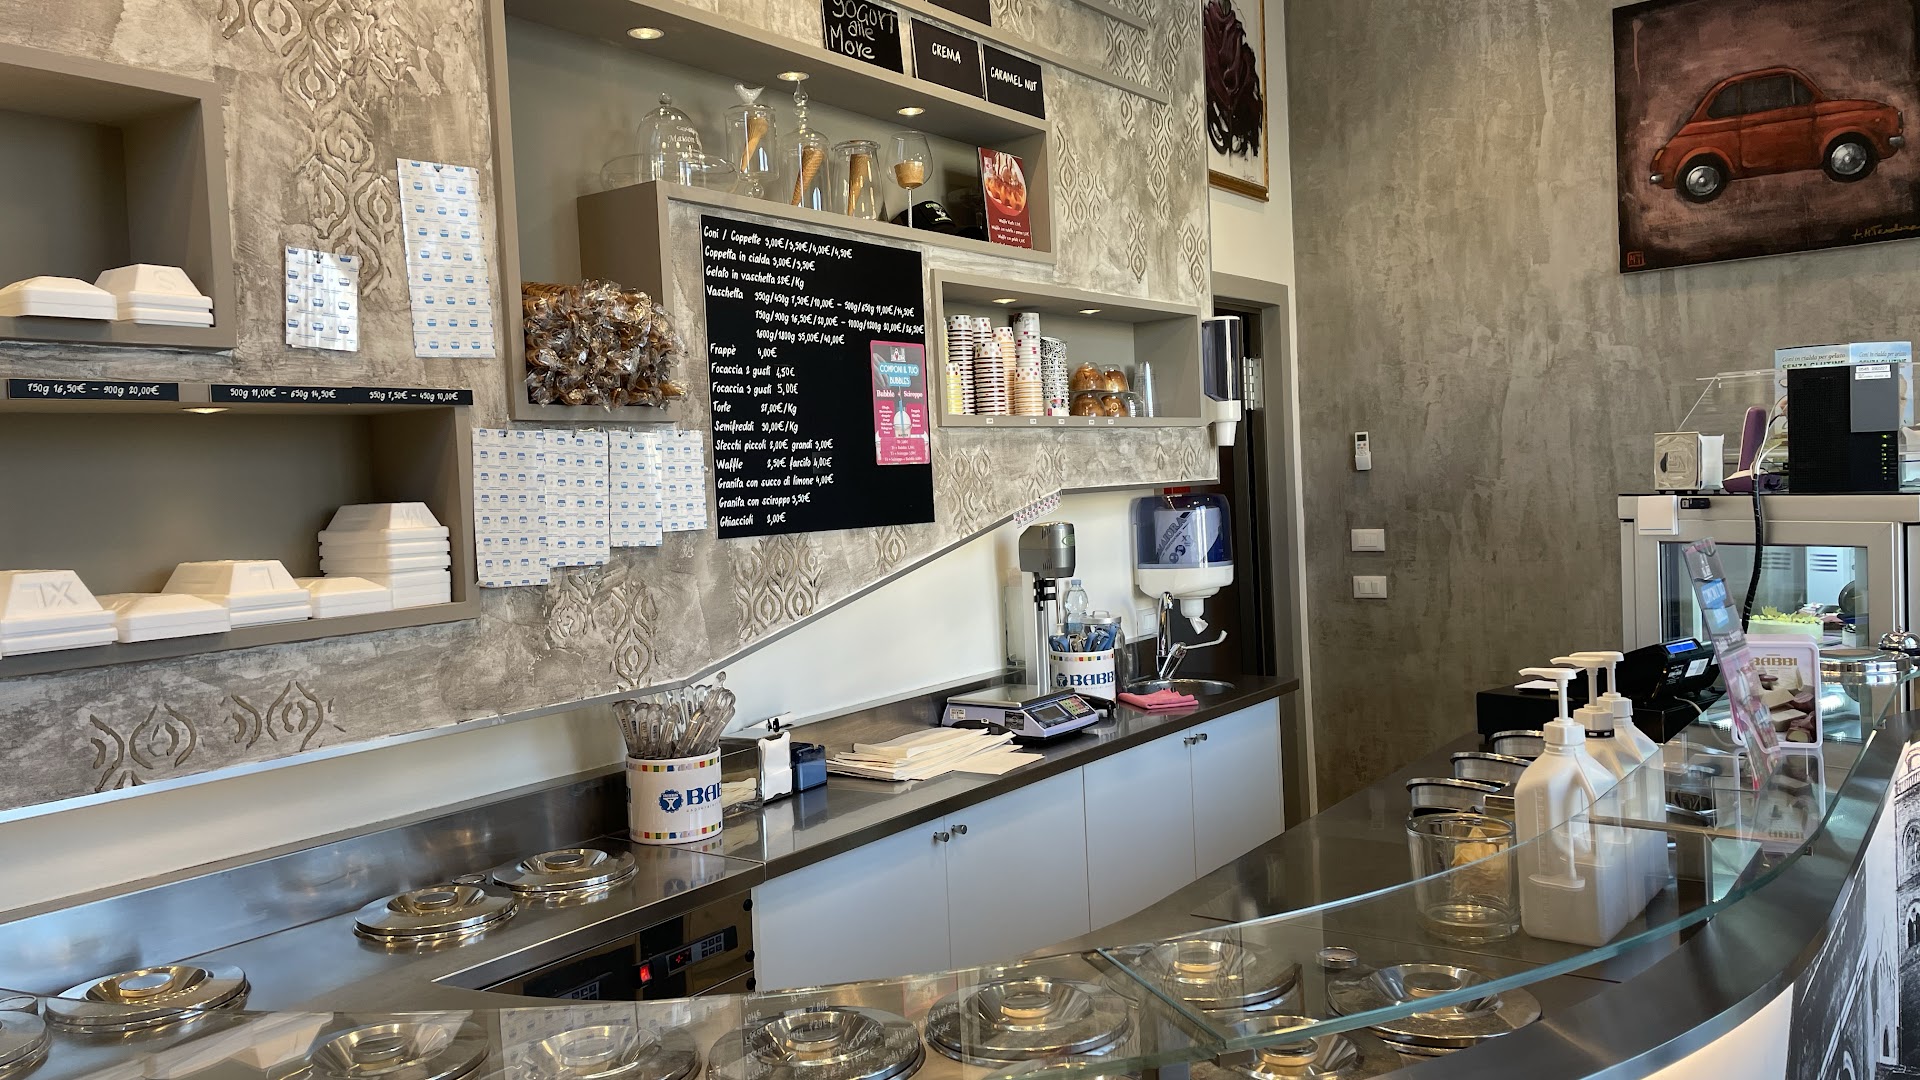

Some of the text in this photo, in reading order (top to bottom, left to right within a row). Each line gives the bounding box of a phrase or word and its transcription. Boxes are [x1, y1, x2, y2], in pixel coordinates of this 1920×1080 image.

[932, 42, 961, 64] CREMA
[990, 66, 1037, 92] CARAMEL NUT
[704, 226, 719, 238] Coni
[731, 230, 761, 245] Coppette
[705, 245, 736, 261] Coppetta
[739, 252, 746, 262] in
[748, 253, 770, 265] cialda
[706, 265, 729, 279] Gelato
[732, 269, 738, 280] in
[741, 272, 775, 284] vaschetta
[706, 285, 743, 299] Vaschetta
[710, 343, 777, 359] Frappè 4,00€
[711, 362, 795, 379] Focaccia 2 gusti 4,50€
[890, 377, 910, 385] BUBBLES
[27, 383, 49, 395] 750g
[53, 383, 87, 396] 16,50€
[103, 385, 124, 397] 900g
[128, 385, 160, 397] 20,00€
[230, 388, 249, 399] 500g
[251, 387, 277, 399] 11,00€
[290, 389, 309, 400] 650g
[311, 389, 337, 400] 14,50€
[712, 381, 799, 397] Focaccia 3 gusti 5,00€
[877, 390, 895, 398] Bubble
[904, 391, 923, 399] Sciroppo
[420, 392, 435, 402] 450g
[437, 392, 458, 402] 10,00€
[713, 401, 732, 413] Torte
[714, 420, 754, 434] Semifreddi
[715, 439, 742, 451] Stecchi
[744, 439, 767, 453] piccoli
[791, 439, 813, 452] grandi
[716, 458, 744, 472] Waffle
[789, 456, 812, 471] farcito
[813, 457, 833, 469] 4,00€
[718, 477, 744, 489] Granita
[746, 479, 759, 488] con
[761, 479, 782, 487] succo
[783, 475, 791, 486] di
[792, 474, 814, 486] limone
[719, 496, 745, 508] Granita
[747, 498, 759, 507] con
[762, 495, 791, 507] sciroppo
[720, 513, 754, 527] Ghiaccioli
